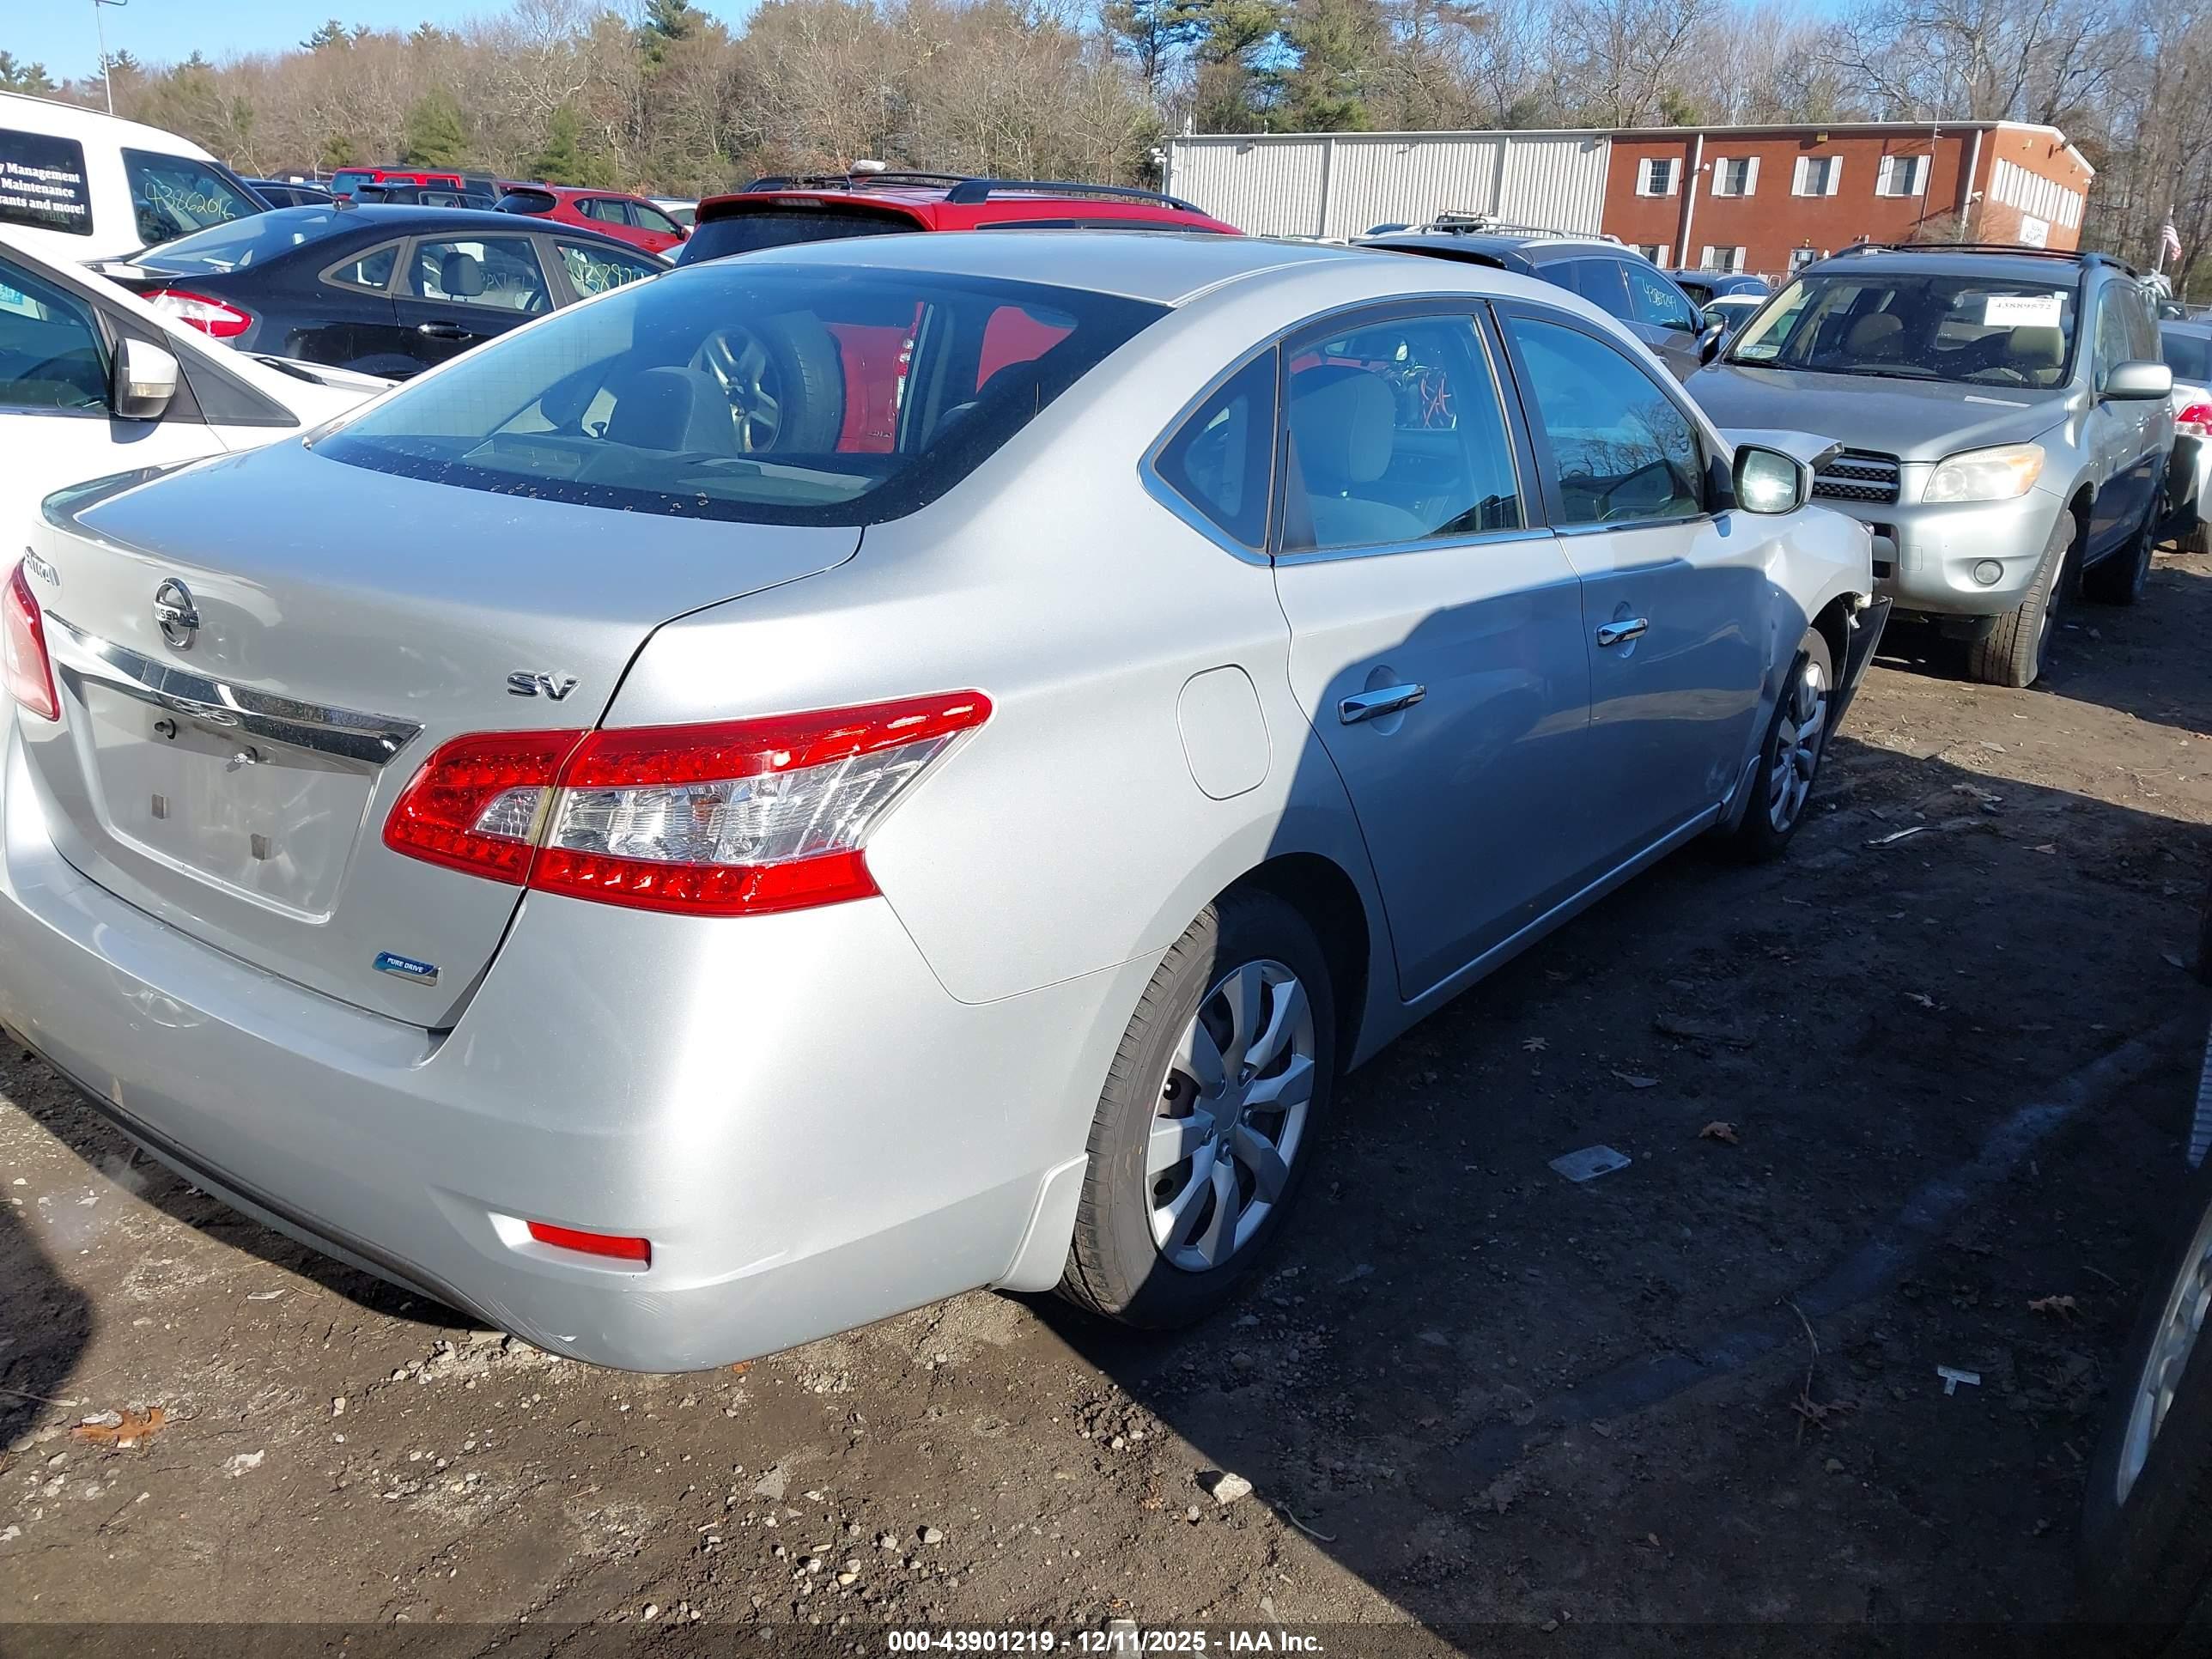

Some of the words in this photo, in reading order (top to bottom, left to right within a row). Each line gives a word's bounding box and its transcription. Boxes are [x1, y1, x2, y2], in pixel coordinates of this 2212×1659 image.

[6, 162, 80, 183] Management
[1, 177, 75, 198] Maintenance
[29, 199, 51, 210] and
[53, 203, 85, 215] more!
[145, 183, 235, 220] 43862016
[507, 670, 580, 702] SV
[387, 957, 404, 968] PURE
[404, 962, 423, 973] DRIVE
